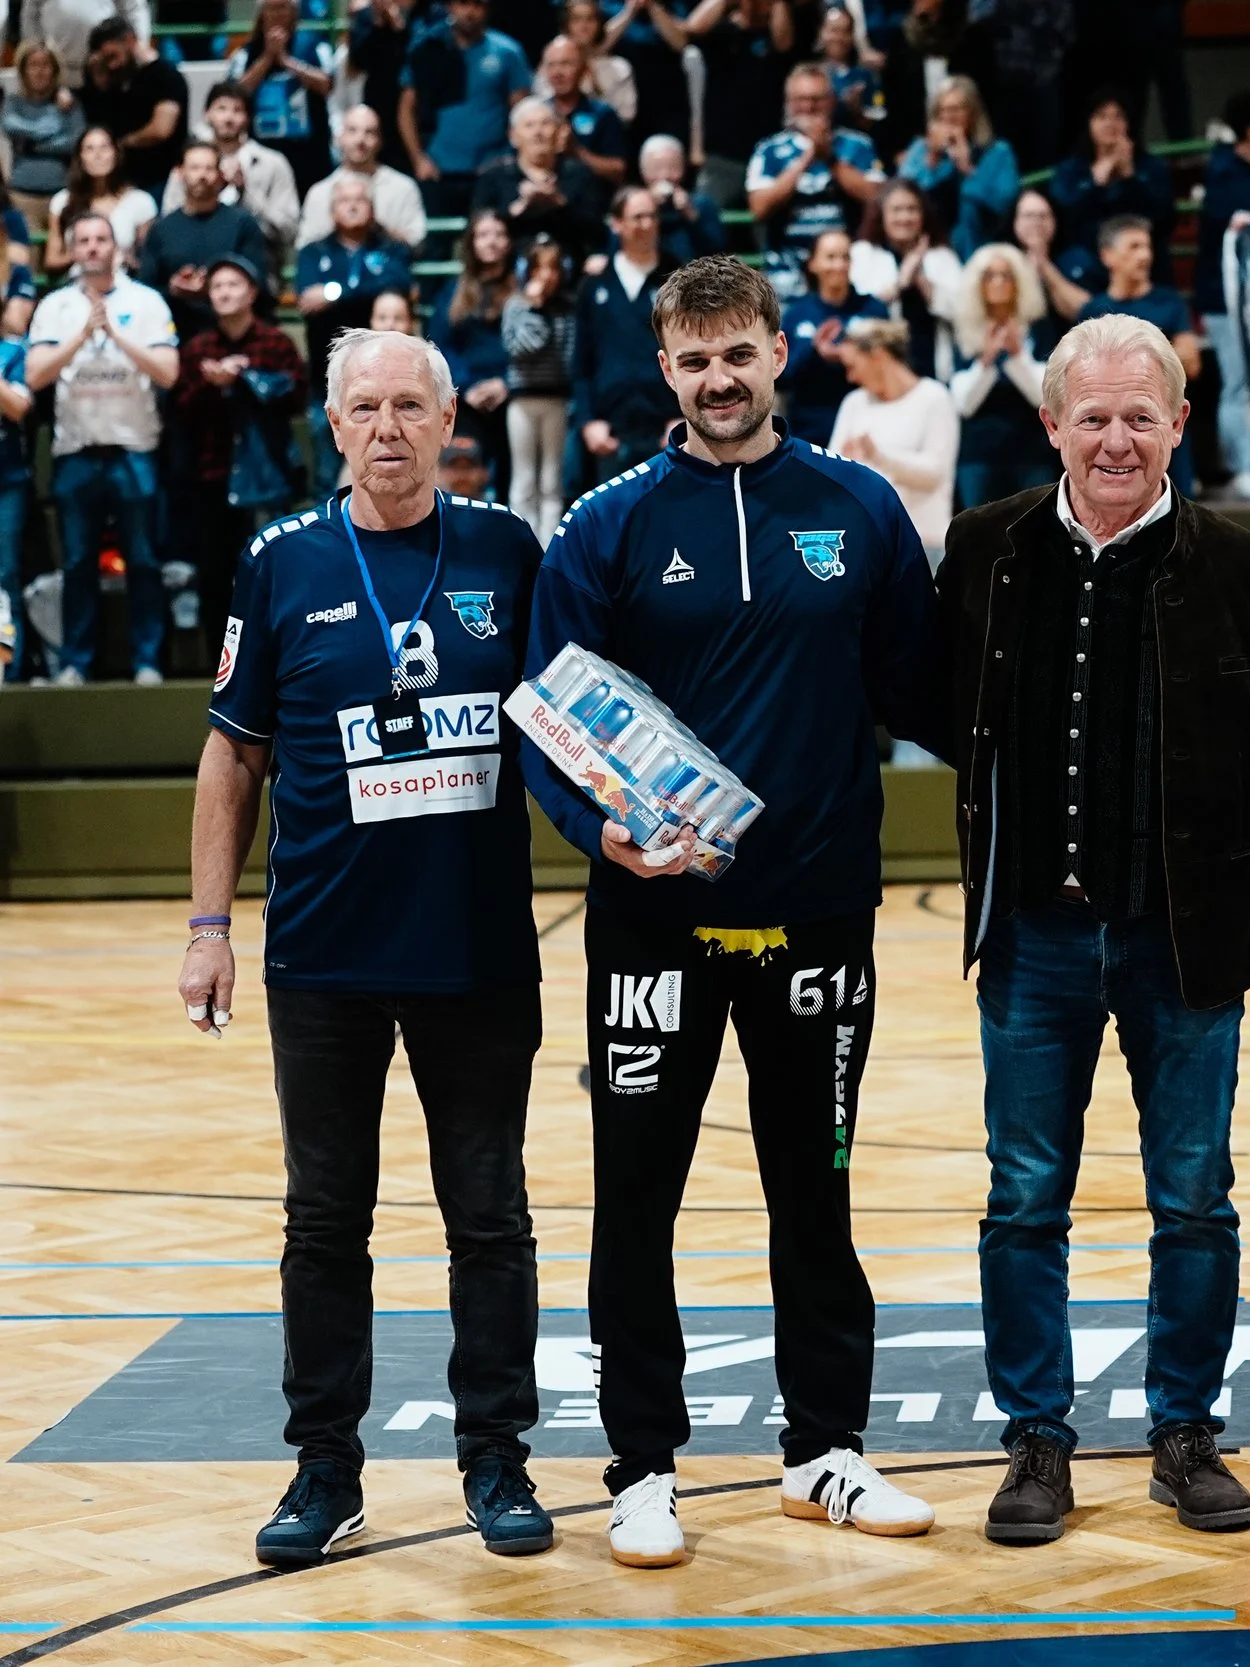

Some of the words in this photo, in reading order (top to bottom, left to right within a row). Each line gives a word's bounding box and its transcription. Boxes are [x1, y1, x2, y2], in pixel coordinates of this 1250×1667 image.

[662, 570, 695, 585] SELECT
[306, 601, 357, 623] capelli
[385, 715, 414, 733] STAFF
[523, 720, 552, 749] ENERGY
[551, 745, 575, 771] DRINK
[531, 704, 562, 738] Red
[555, 728, 587, 762] Bull
[358, 768, 491, 798] kosaplaner
[604, 973, 655, 1029] JK
[666, 974, 676, 1028] CONSULTING
[789, 964, 846, 1016] 61
